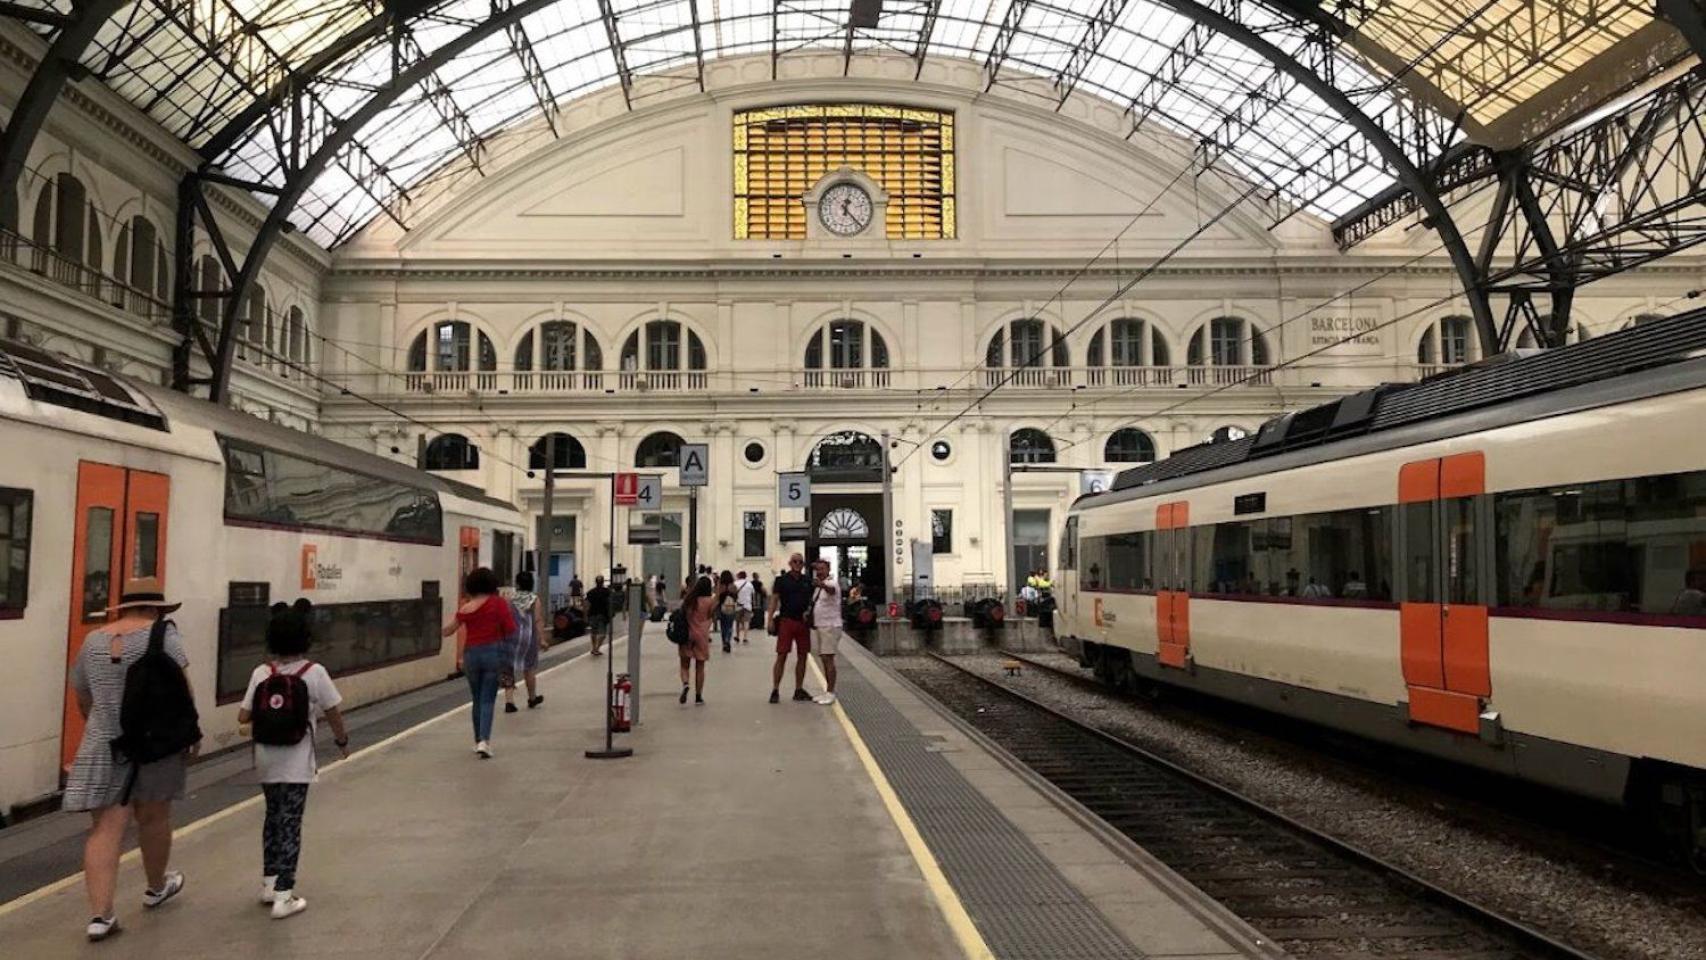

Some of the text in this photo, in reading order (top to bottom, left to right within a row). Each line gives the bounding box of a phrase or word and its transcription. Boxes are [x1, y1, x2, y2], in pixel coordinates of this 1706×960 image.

[1311, 317, 1378, 331] BARCELONA
[684, 450, 703, 472] A
[638, 484, 652, 503] 4
[788, 482, 801, 501] 5
[1090, 479, 1103, 495] 6
